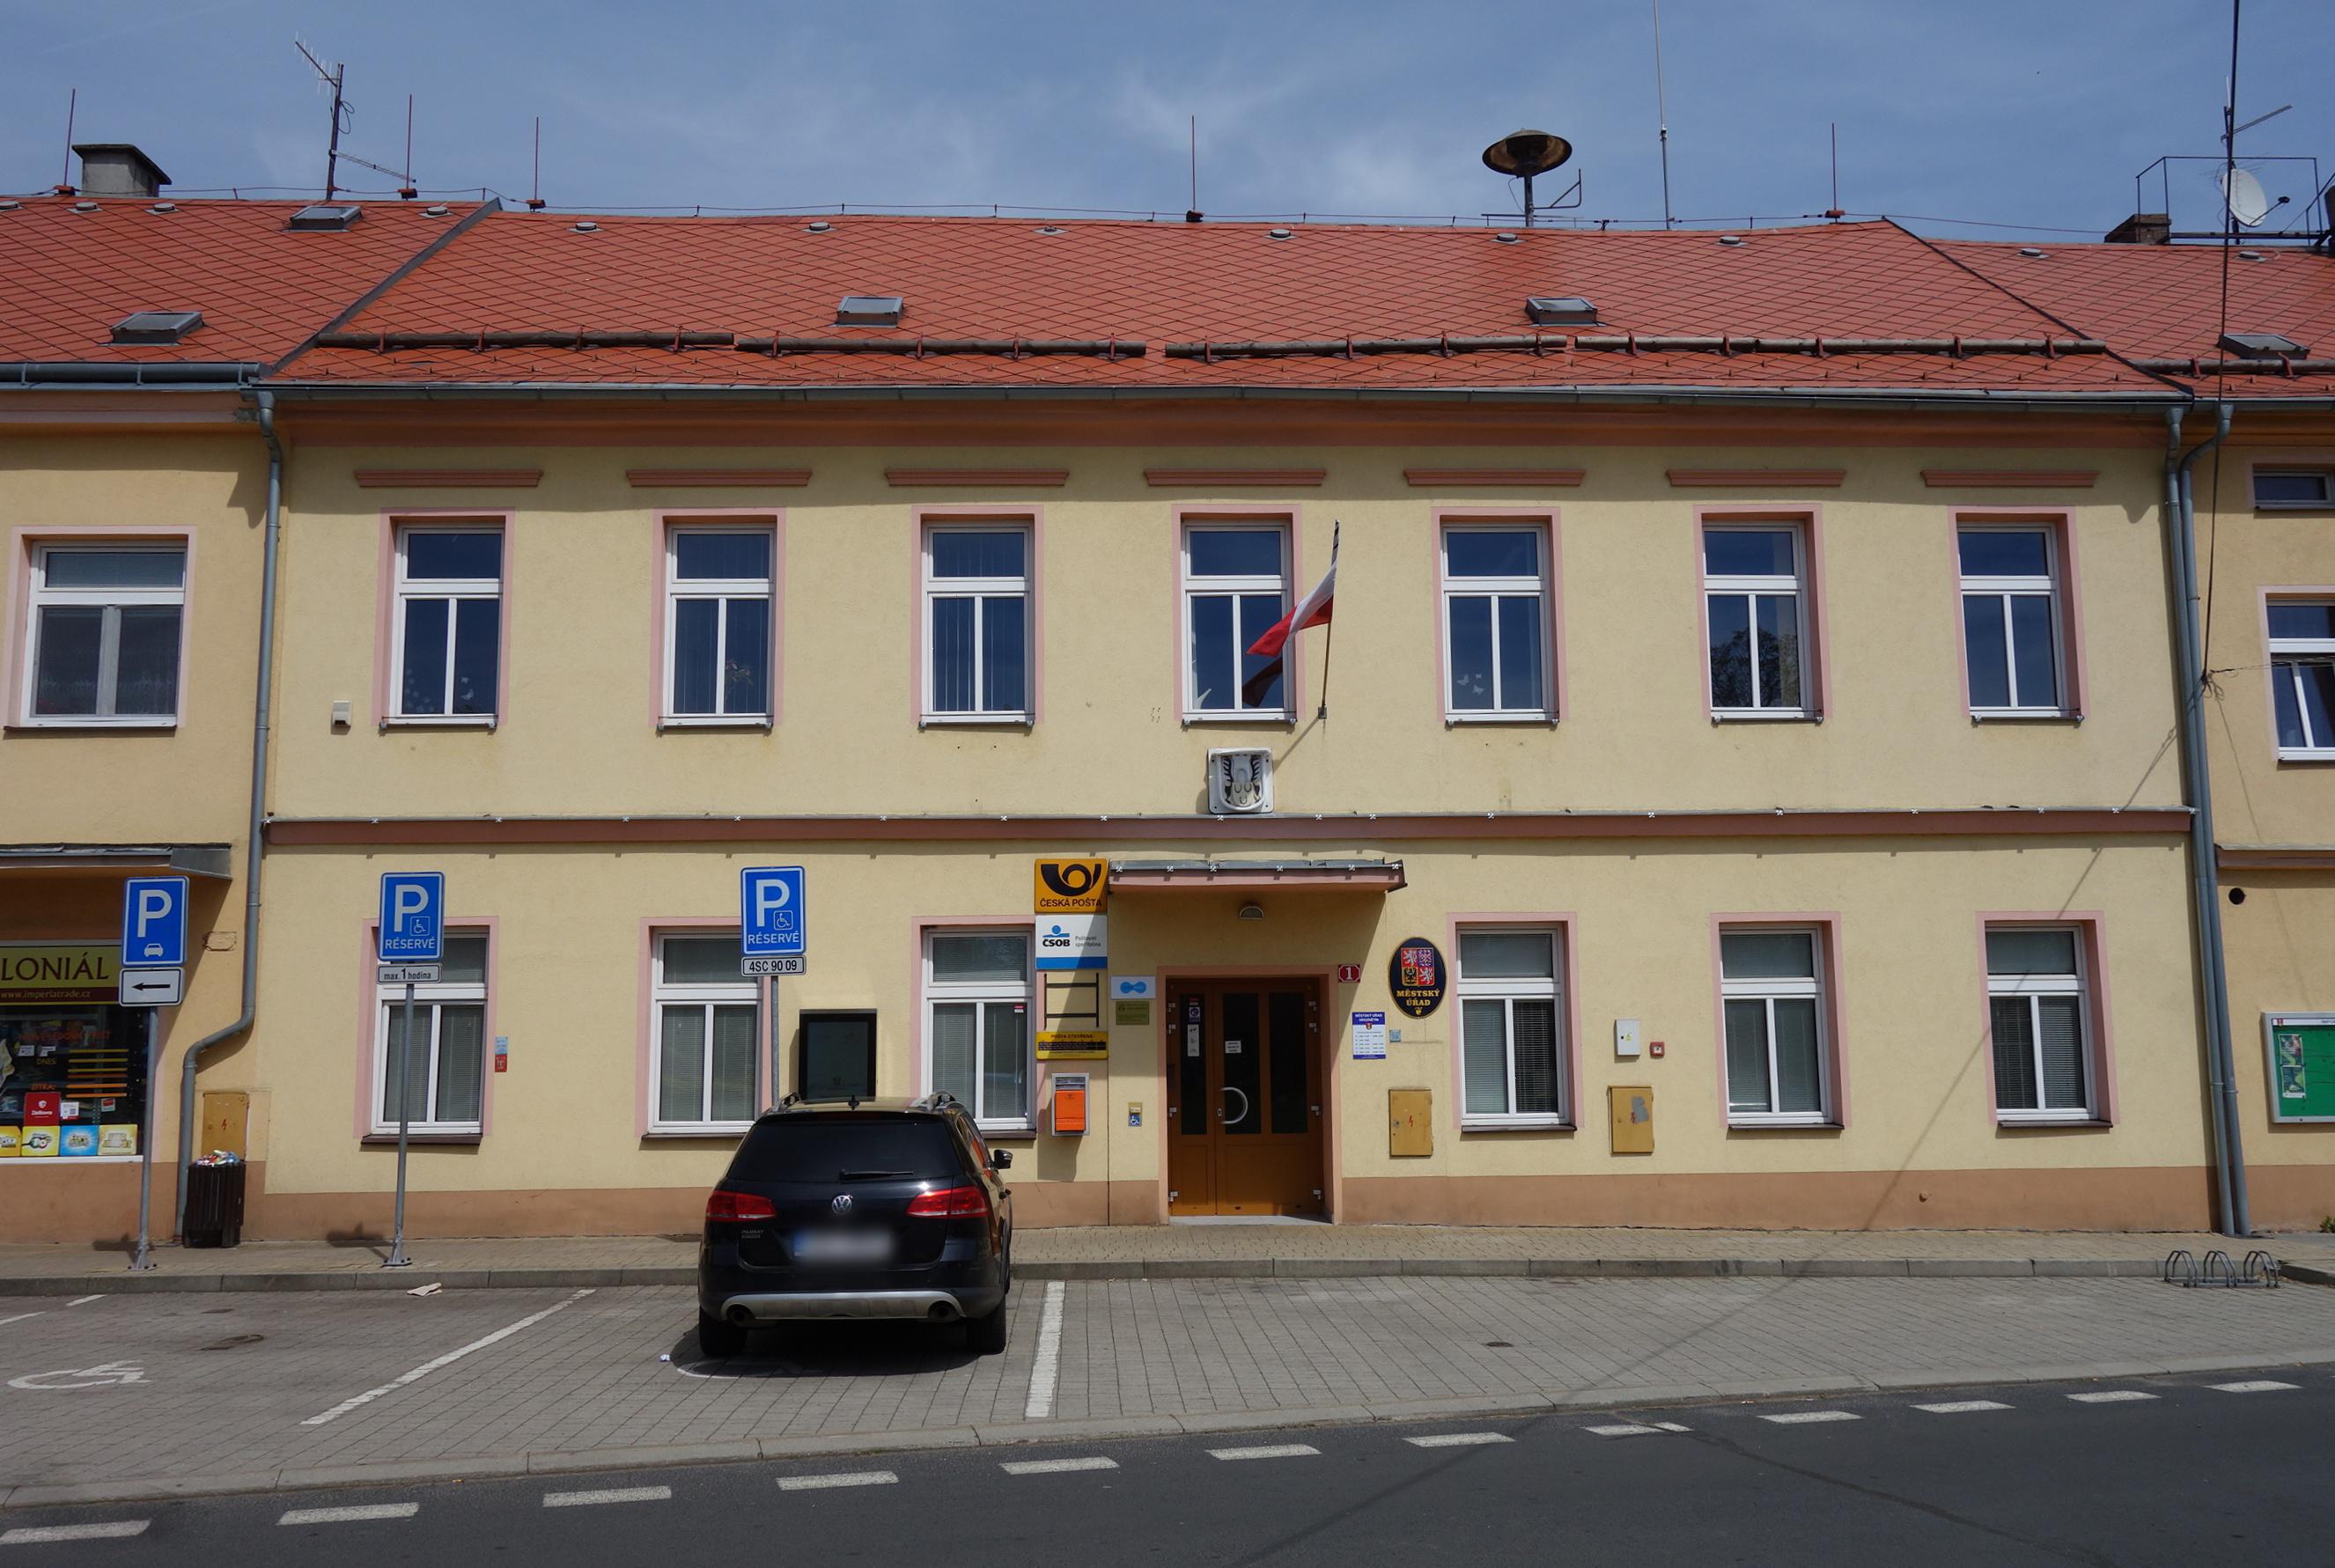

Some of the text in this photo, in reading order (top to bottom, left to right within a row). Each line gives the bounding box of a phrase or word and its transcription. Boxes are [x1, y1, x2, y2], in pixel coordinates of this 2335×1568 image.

[394, 884, 429, 931] P
[755, 879, 790, 927] P
[1040, 897, 1102, 907] ČESKÁ POŠTA
[136, 889, 173, 938] P
[385, 937, 436, 950] RÉSERVÉ
[748, 930, 800, 945] RÉSERVÉ
[1042, 938, 1071, 947] ČSOB
[749, 960, 798, 973] 4SC 90 09
[1345, 966, 1352, 980] 1
[384, 972, 401, 981] max.
[408, 971, 431, 980] hodina
[1396, 989, 1440, 997] MĚSTSKÝ
[1406, 997, 1431, 1006] ÚŘAD
